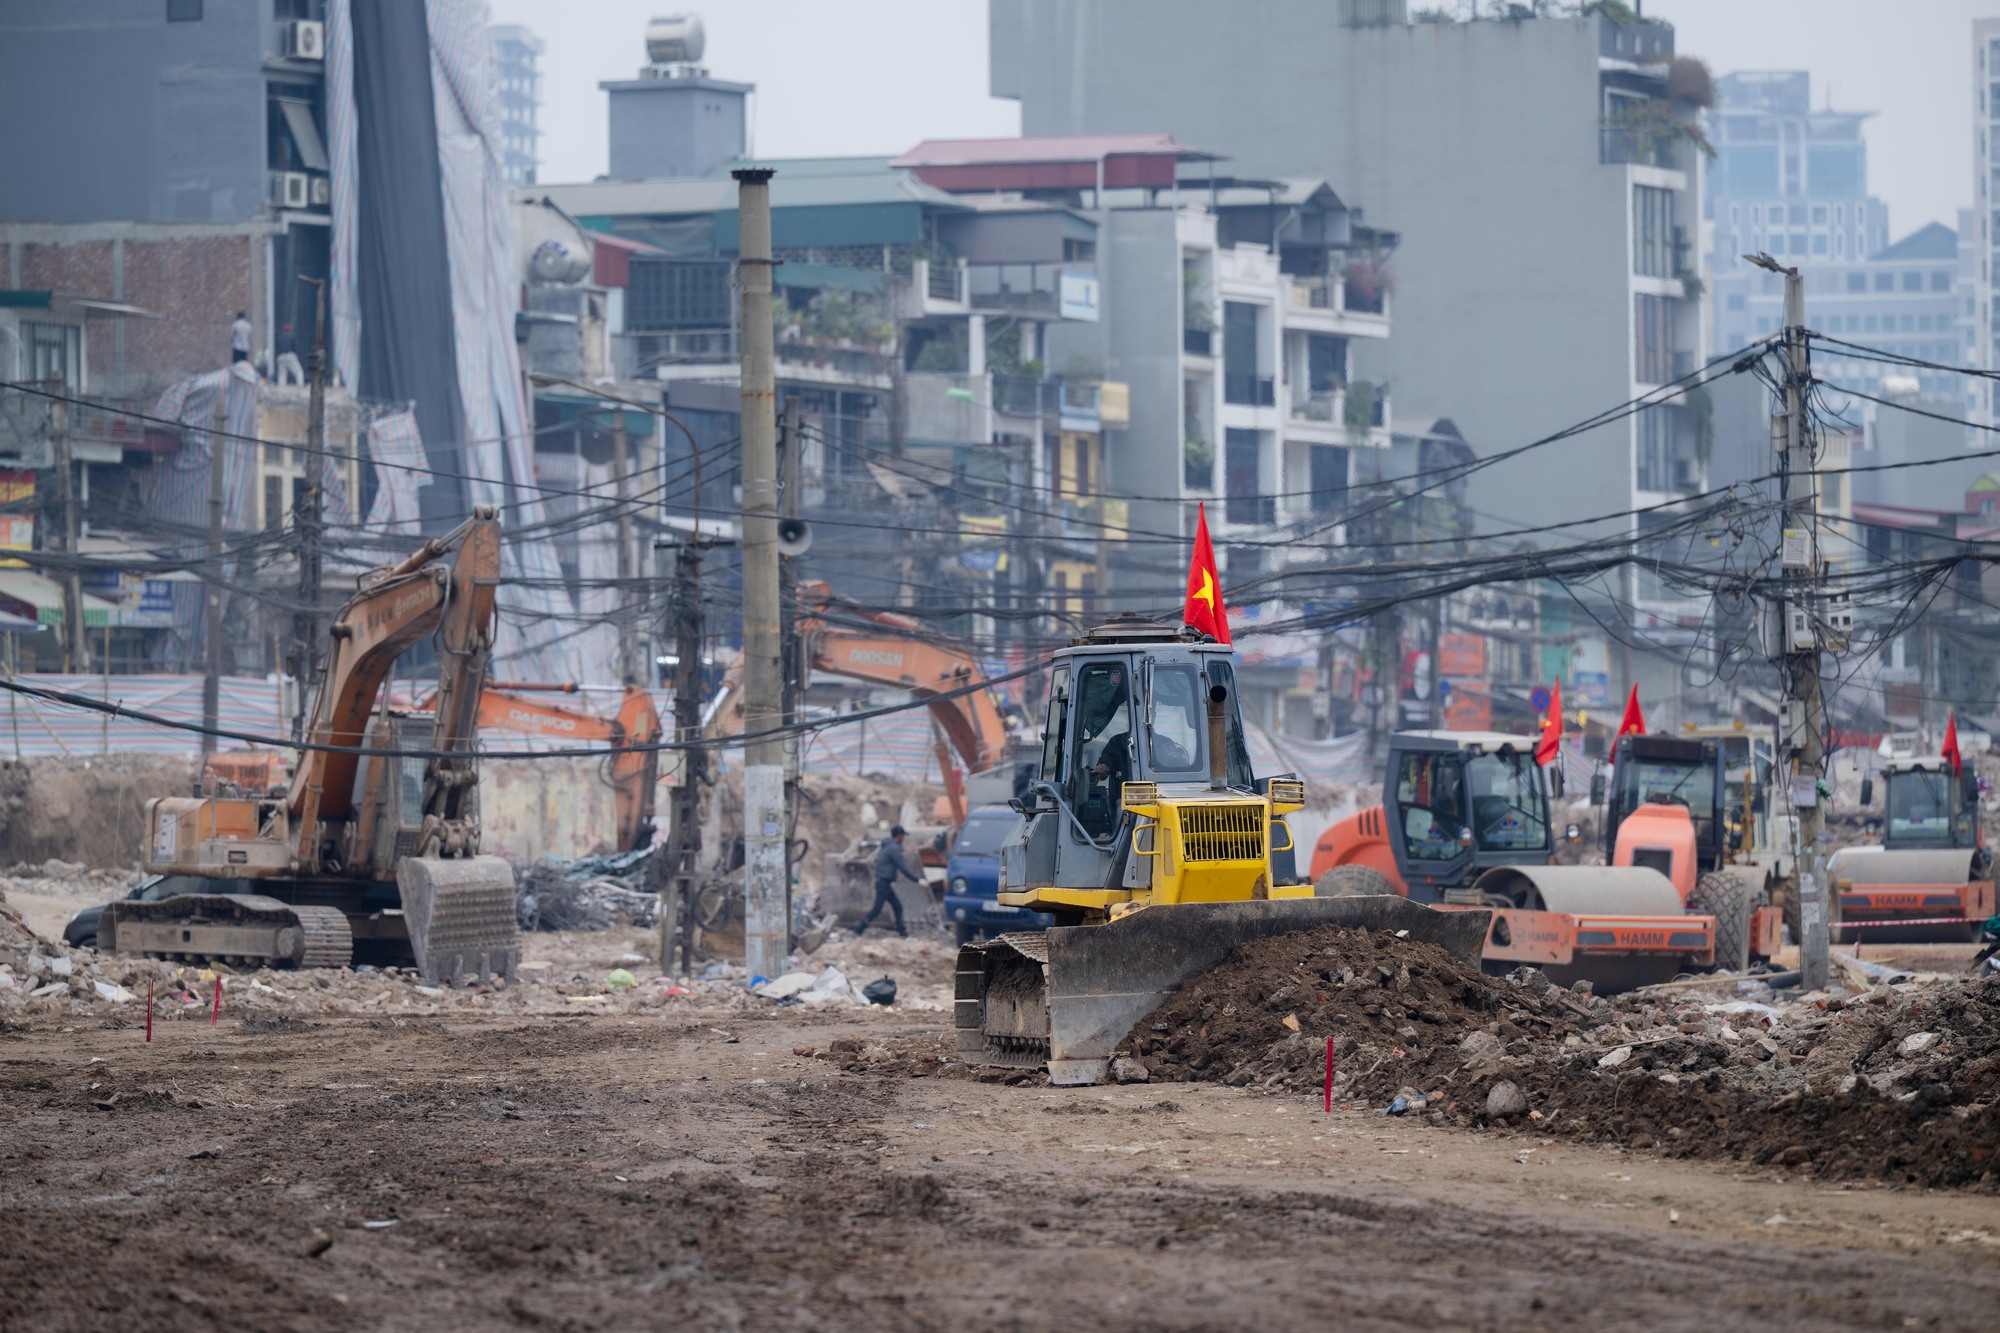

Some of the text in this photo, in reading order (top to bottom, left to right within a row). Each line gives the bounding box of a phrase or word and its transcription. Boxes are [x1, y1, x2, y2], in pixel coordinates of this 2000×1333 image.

[849, 649, 902, 667] DOOSAN
[509, 709, 575, 730] DAEWOO
[1875, 896, 1918, 906] HAMM
[1528, 930, 1558, 943] HAMM
[1620, 932, 1664, 945] HAMM
